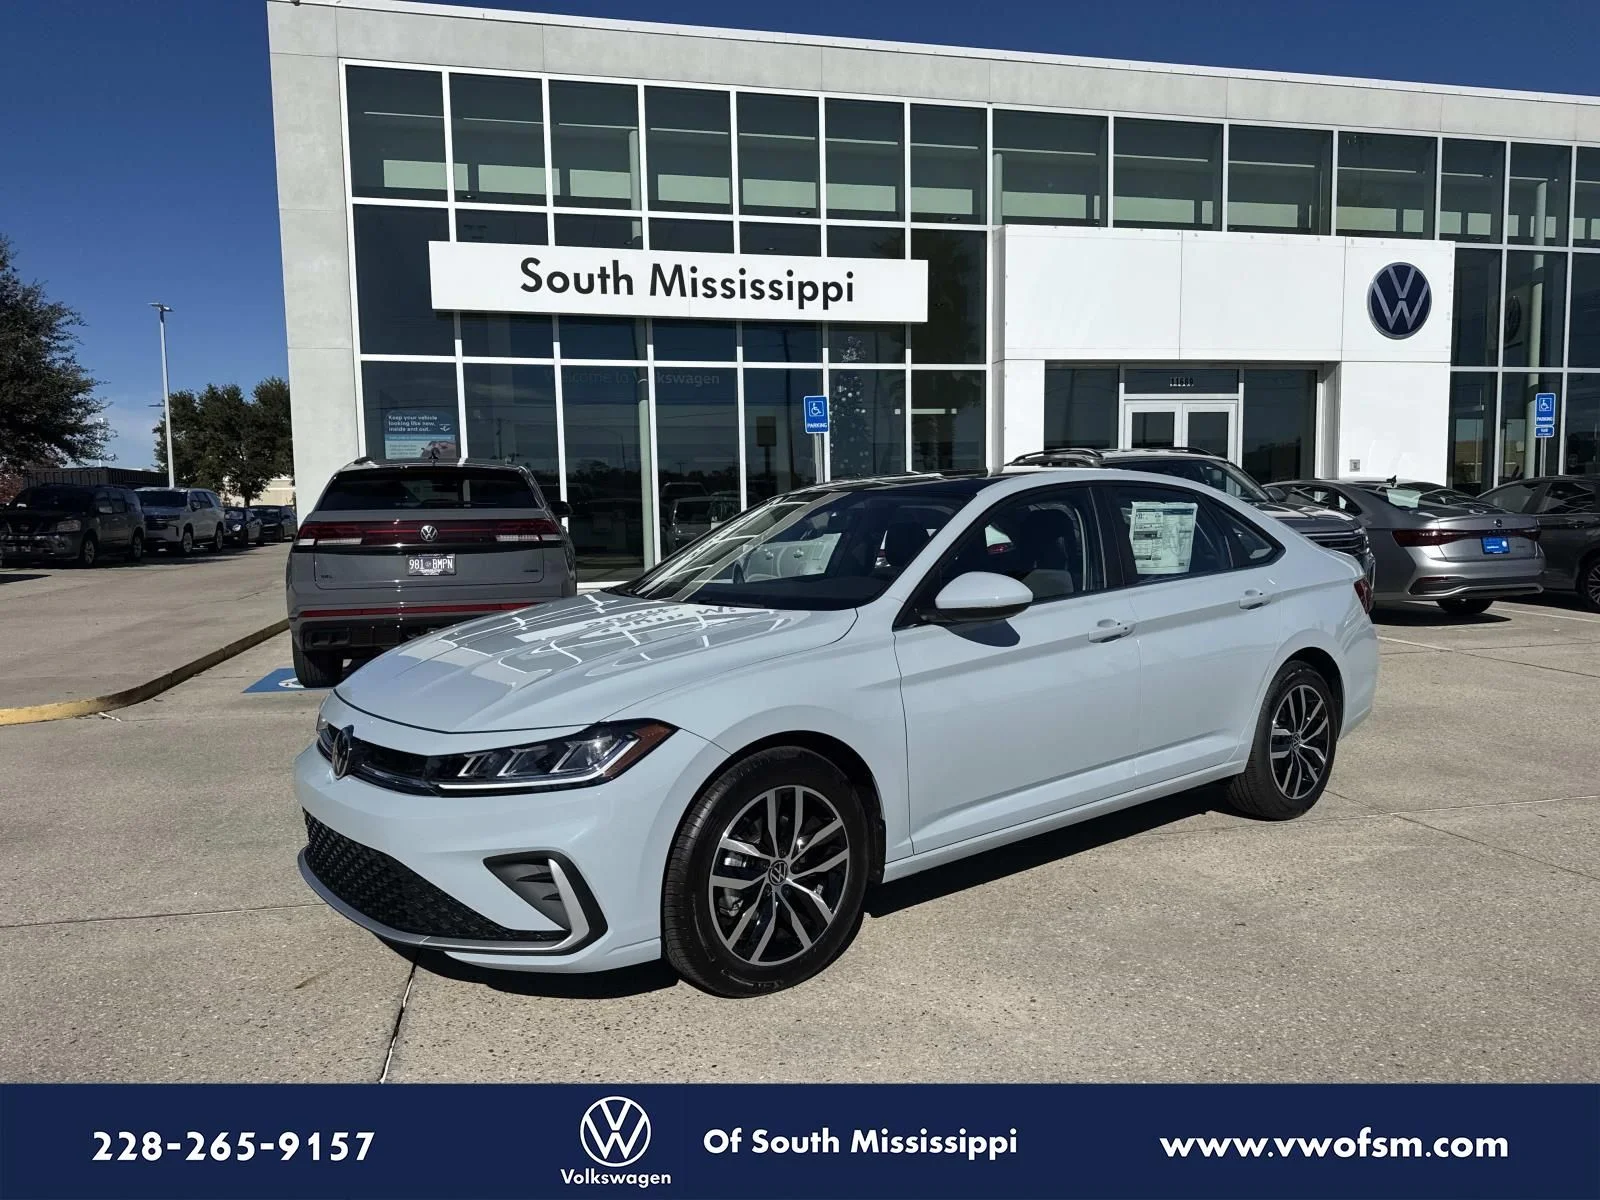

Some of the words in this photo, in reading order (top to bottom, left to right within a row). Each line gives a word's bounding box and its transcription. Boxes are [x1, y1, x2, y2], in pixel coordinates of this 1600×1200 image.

[521, 257, 633, 295] South
[650, 263, 854, 310] Mississippi
[1368, 263, 1431, 338] VW
[635, 371, 720, 387] kswagen
[409, 558, 424, 570] 981
